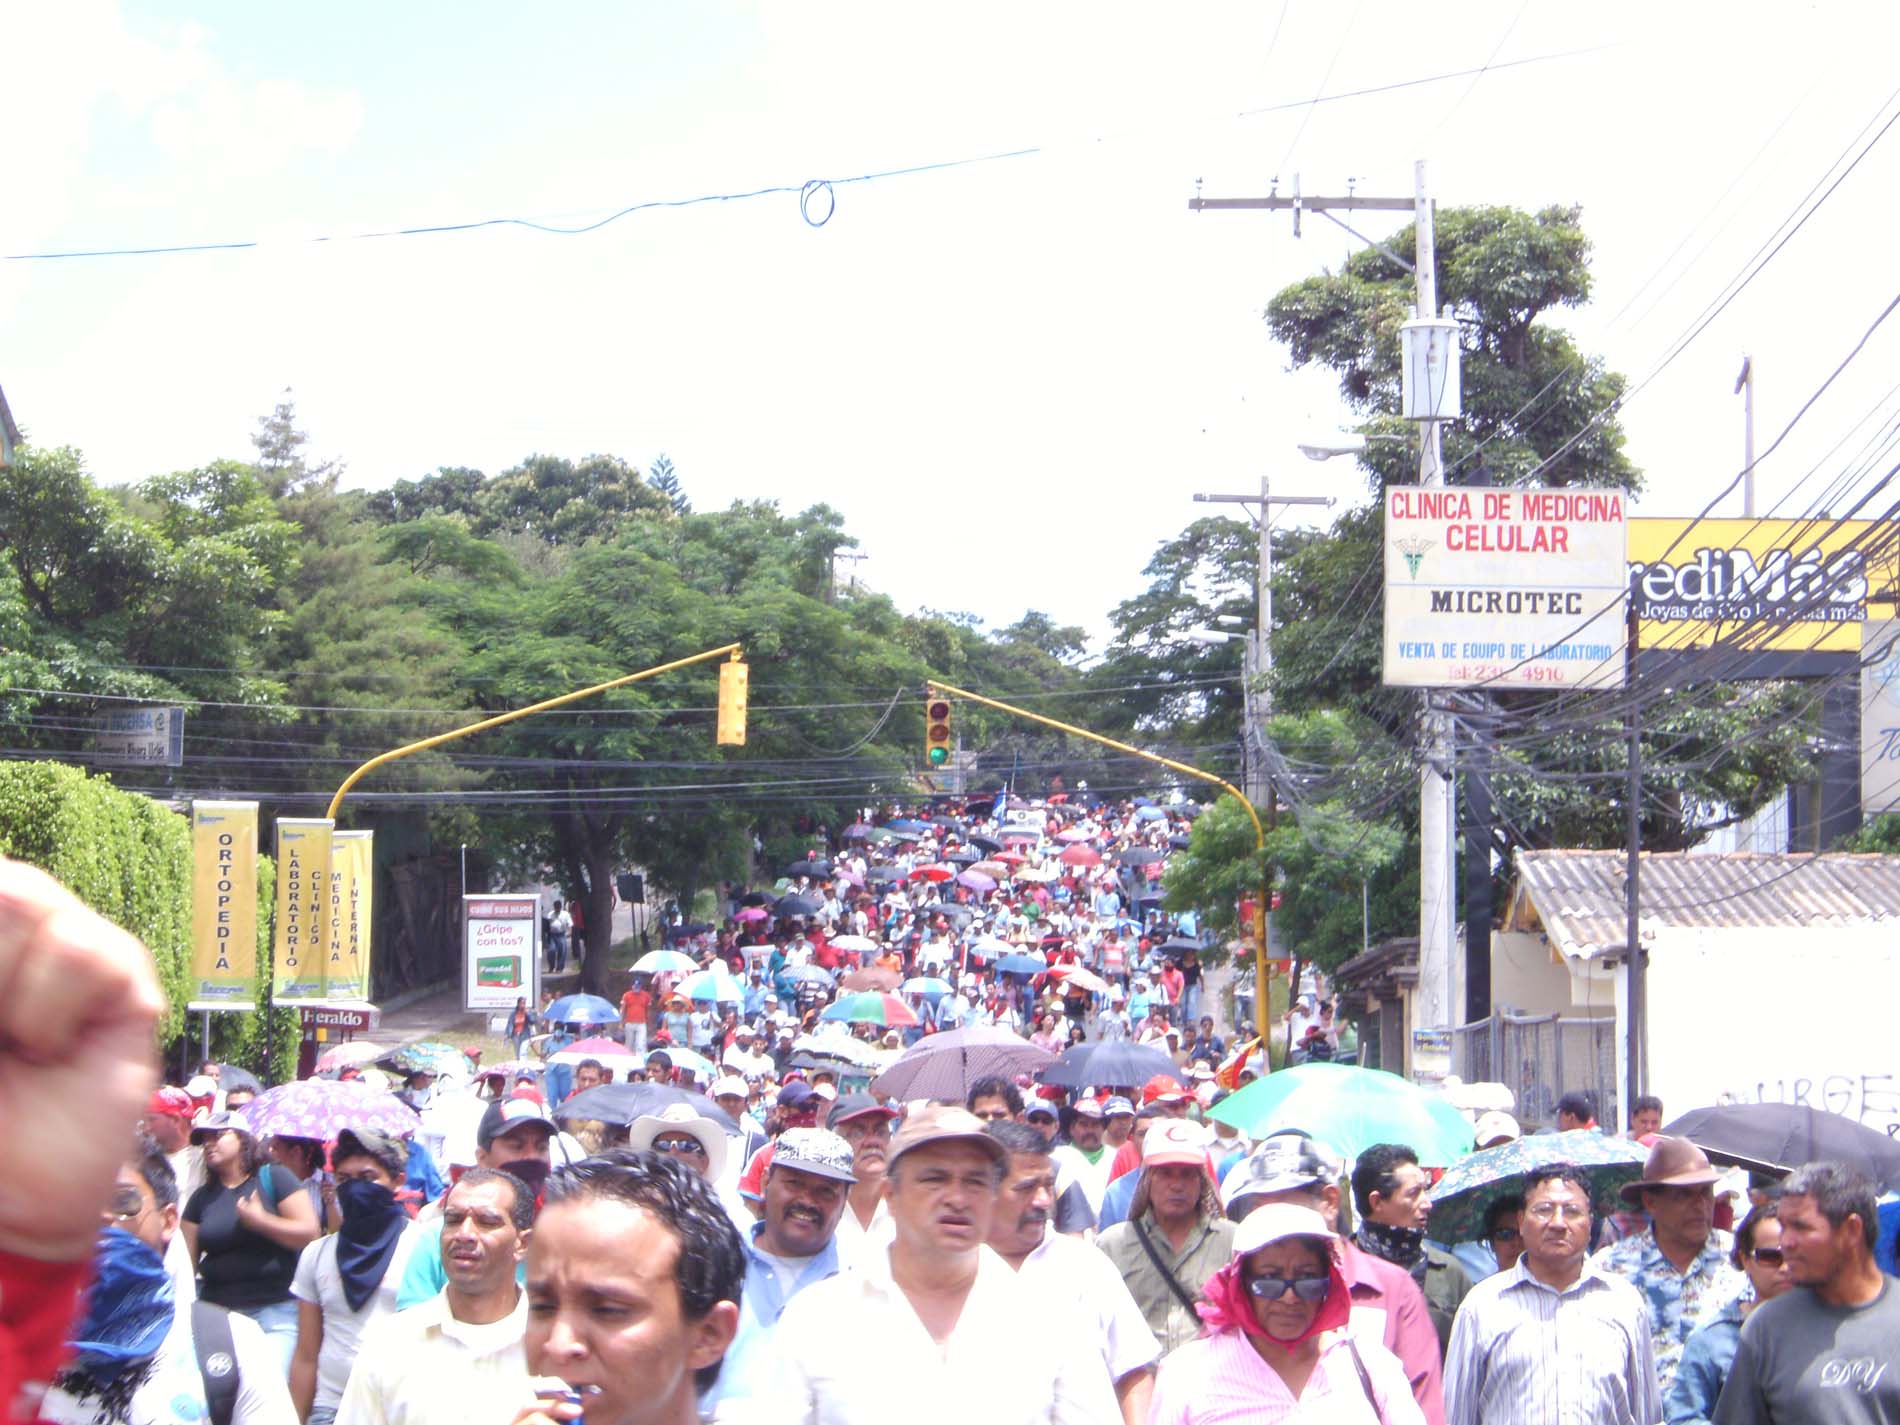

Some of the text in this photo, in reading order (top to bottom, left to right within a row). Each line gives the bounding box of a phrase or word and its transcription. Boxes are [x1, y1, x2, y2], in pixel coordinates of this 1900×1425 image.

[1391, 492, 1622, 522] CLINICA DE MEDICINA
[1446, 524, 1568, 553] CELULAR
[1430, 590, 1583, 615] MICROTEC
[1640, 601, 1688, 621] Joyas
[1692, 602, 1713, 620] de
[1399, 642, 1613, 661] VENTA DE EQUIPO DE LABORATORIO
[215, 833, 233, 969] ORTOPEDIA
[286, 849, 300, 967] LABORATORIO
[310, 871, 321, 945] CLINICO
[330, 872, 342, 961] MEDICINA
[350, 878, 359, 955] INTERNA
[477, 924, 512, 936] ¿Gripe
[477, 936, 523, 946] con tos?
[303, 1009, 363, 1026] Heraldo
